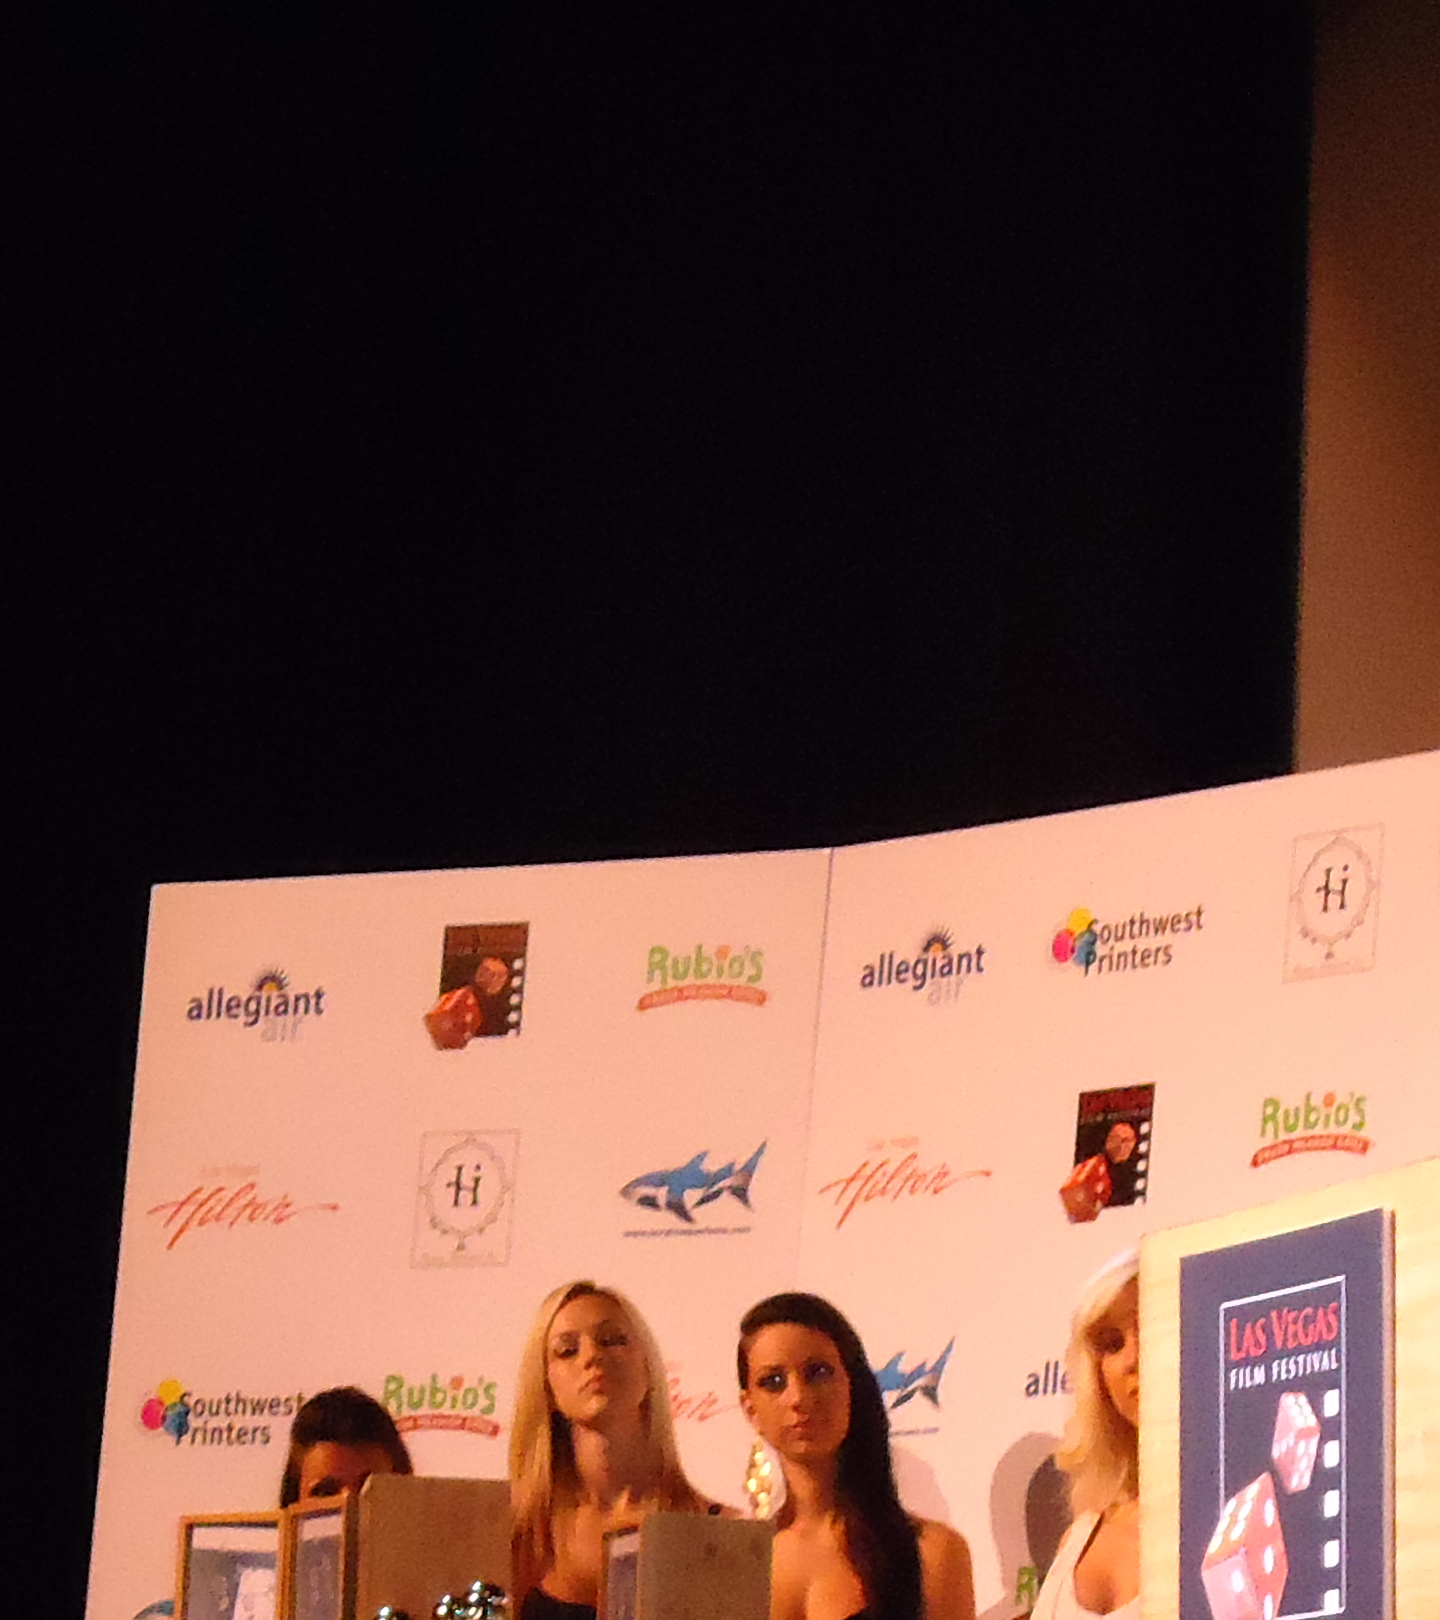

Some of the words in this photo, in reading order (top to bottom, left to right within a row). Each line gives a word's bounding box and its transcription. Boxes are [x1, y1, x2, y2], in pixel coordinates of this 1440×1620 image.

[1084, 903, 1204, 946] Southwest
[647, 944, 765, 987] Rubio's
[860, 944, 987, 991] allegiant
[1084, 943, 1173, 978] Printers
[187, 986, 326, 1028] allegiant
[1260, 1091, 1367, 1140] Rubio's
[818, 1152, 993, 1231] Hilton
[147, 1182, 340, 1250] Hilton
[1230, 1318, 1267, 1361] LAS
[1271, 1302, 1339, 1350] VEGAS
[1229, 1364, 1266, 1391] FILM
[1271, 1347, 1340, 1383] FESTIVAL
[176, 1390, 305, 1418] Southwest
[382, 1374, 497, 1416] Rubio's
[174, 1419, 271, 1446] Printers
